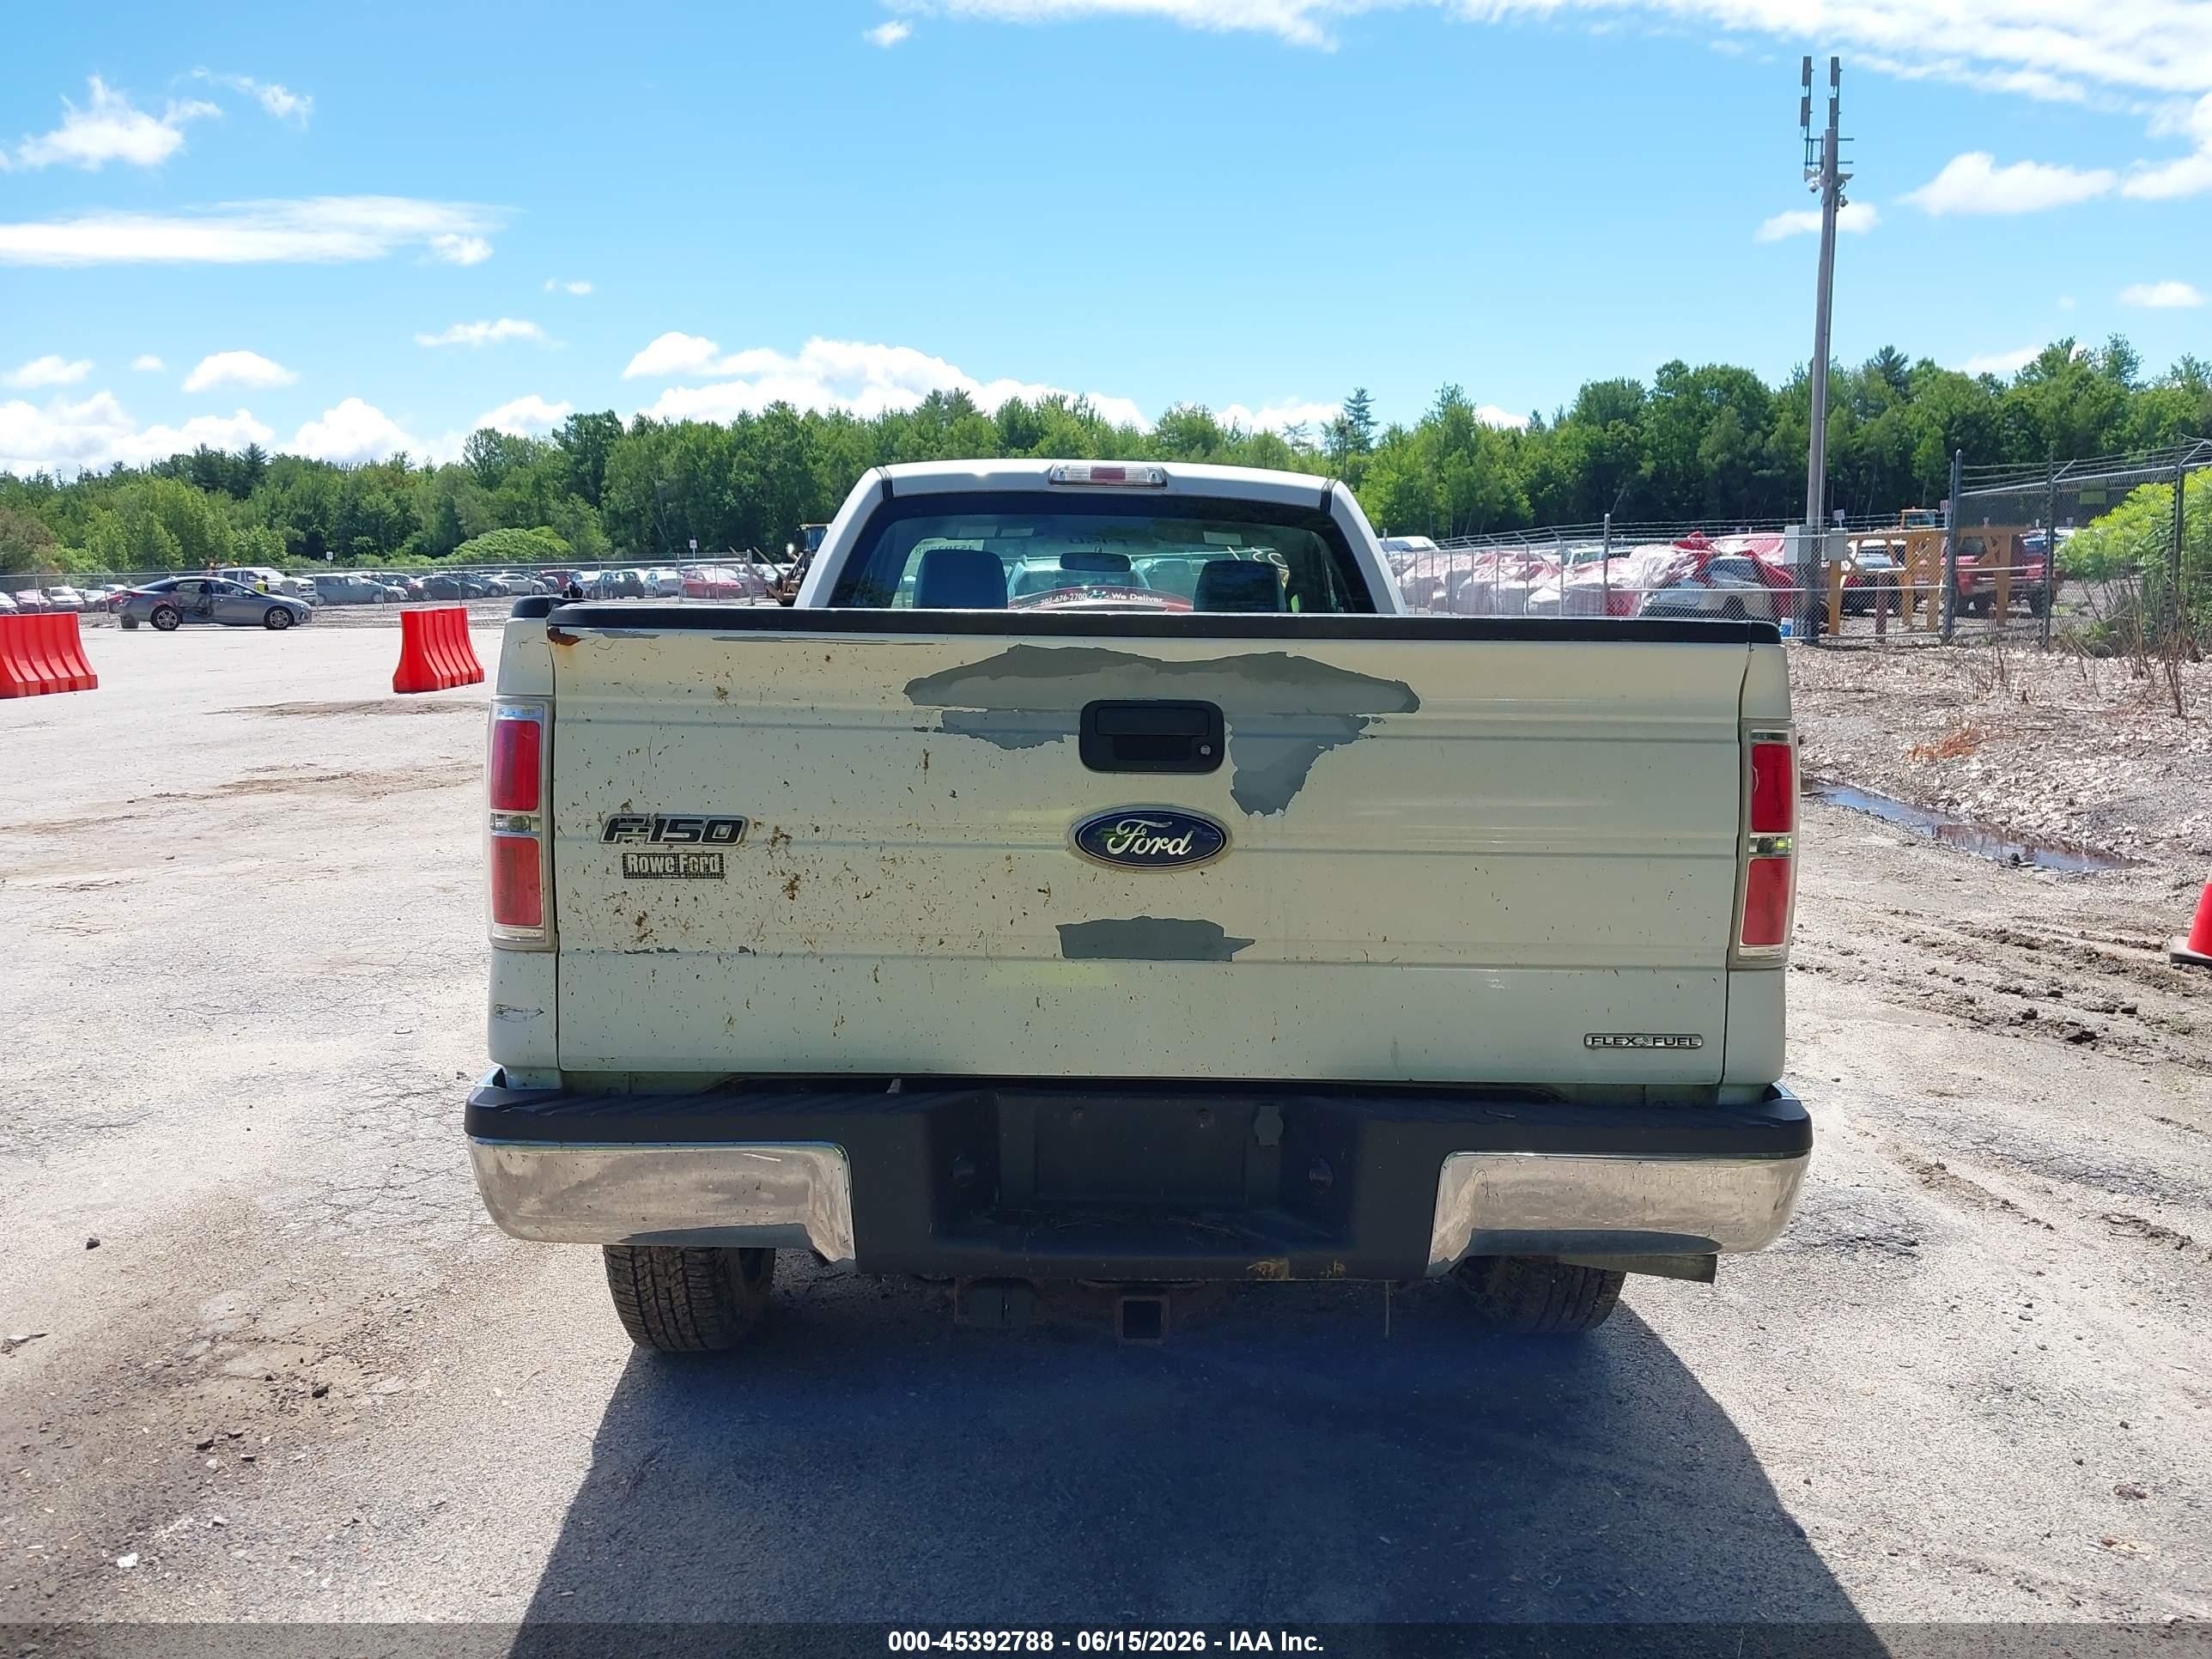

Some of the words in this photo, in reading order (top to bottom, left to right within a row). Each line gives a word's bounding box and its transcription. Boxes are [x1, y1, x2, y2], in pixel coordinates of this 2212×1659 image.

[1040, 592, 1086, 606] 207-676-2700
[1129, 593, 1164, 604] Deliver
[601, 816, 747, 844] F-150
[1106, 818, 1195, 855] Ford
[627, 853, 675, 873] Rowe
[678, 853, 720, 873] Ford
[1590, 1036, 1638, 1046] FLEX
[1652, 1036, 1698, 1047] FUEL
